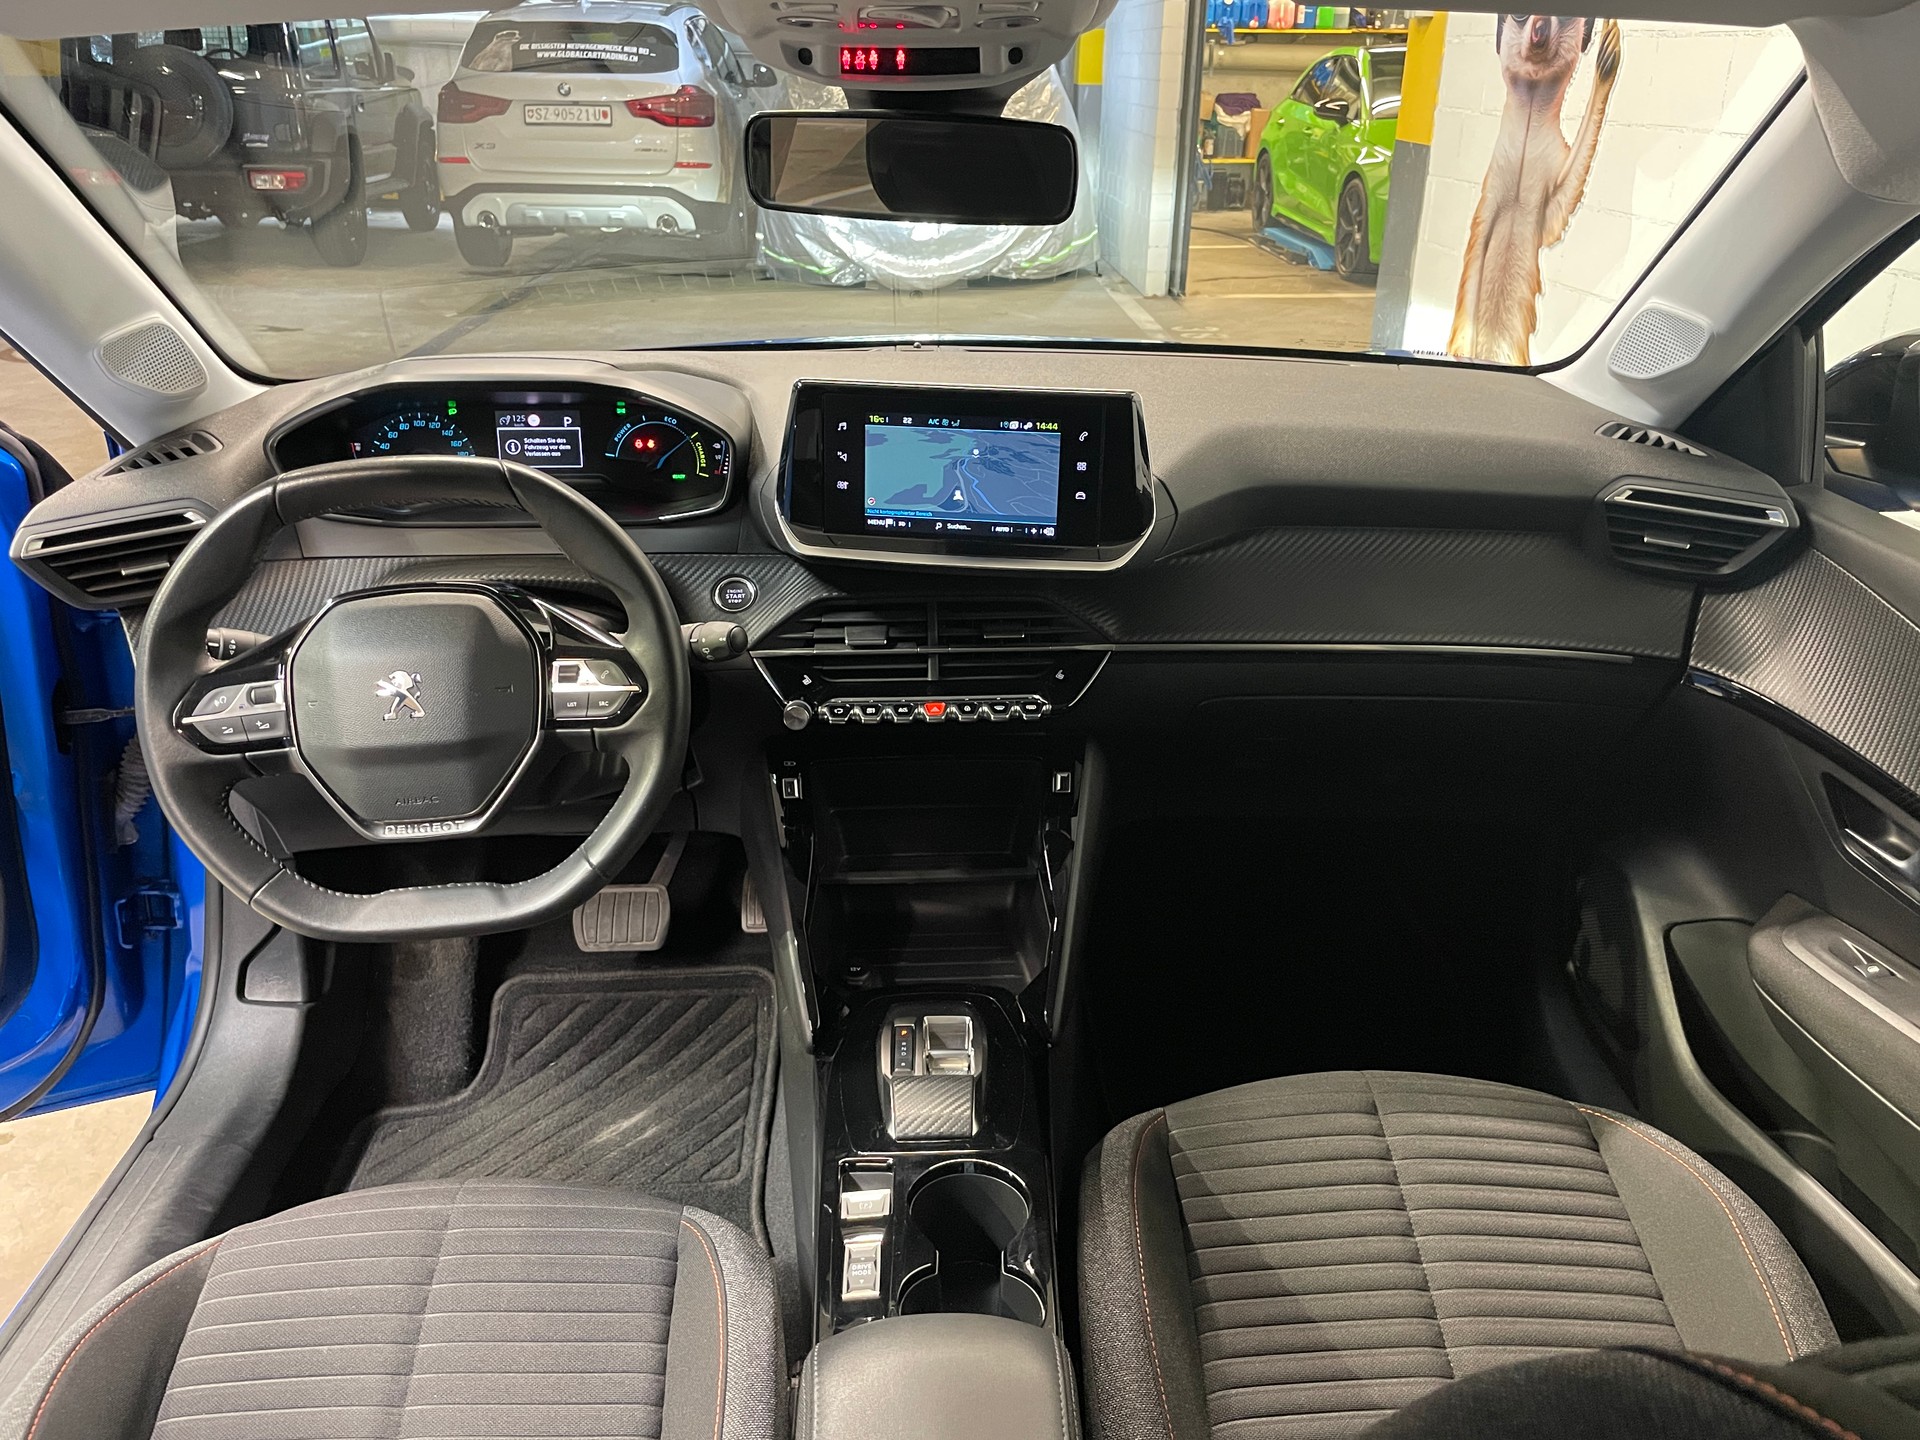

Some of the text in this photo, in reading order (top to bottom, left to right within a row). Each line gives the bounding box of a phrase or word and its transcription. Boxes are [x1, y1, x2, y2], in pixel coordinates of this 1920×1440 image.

[537, 50, 639, 62] WWW.GLOBALCARTRADING.CH
[474, 142, 496, 150] X3
[563, 416, 572, 427] P
[664, 416, 677, 425] ECO
[1036, 422, 1058, 430] 14:44
[614, 423, 632, 442] POWER
[695, 442, 707, 468] CHARGE
[867, 518, 886, 526] MENU
[394, 795, 440, 806] AIRBAG
[384, 820, 465, 835] PEUGEOT
[852, 1269, 872, 1277] MODE
